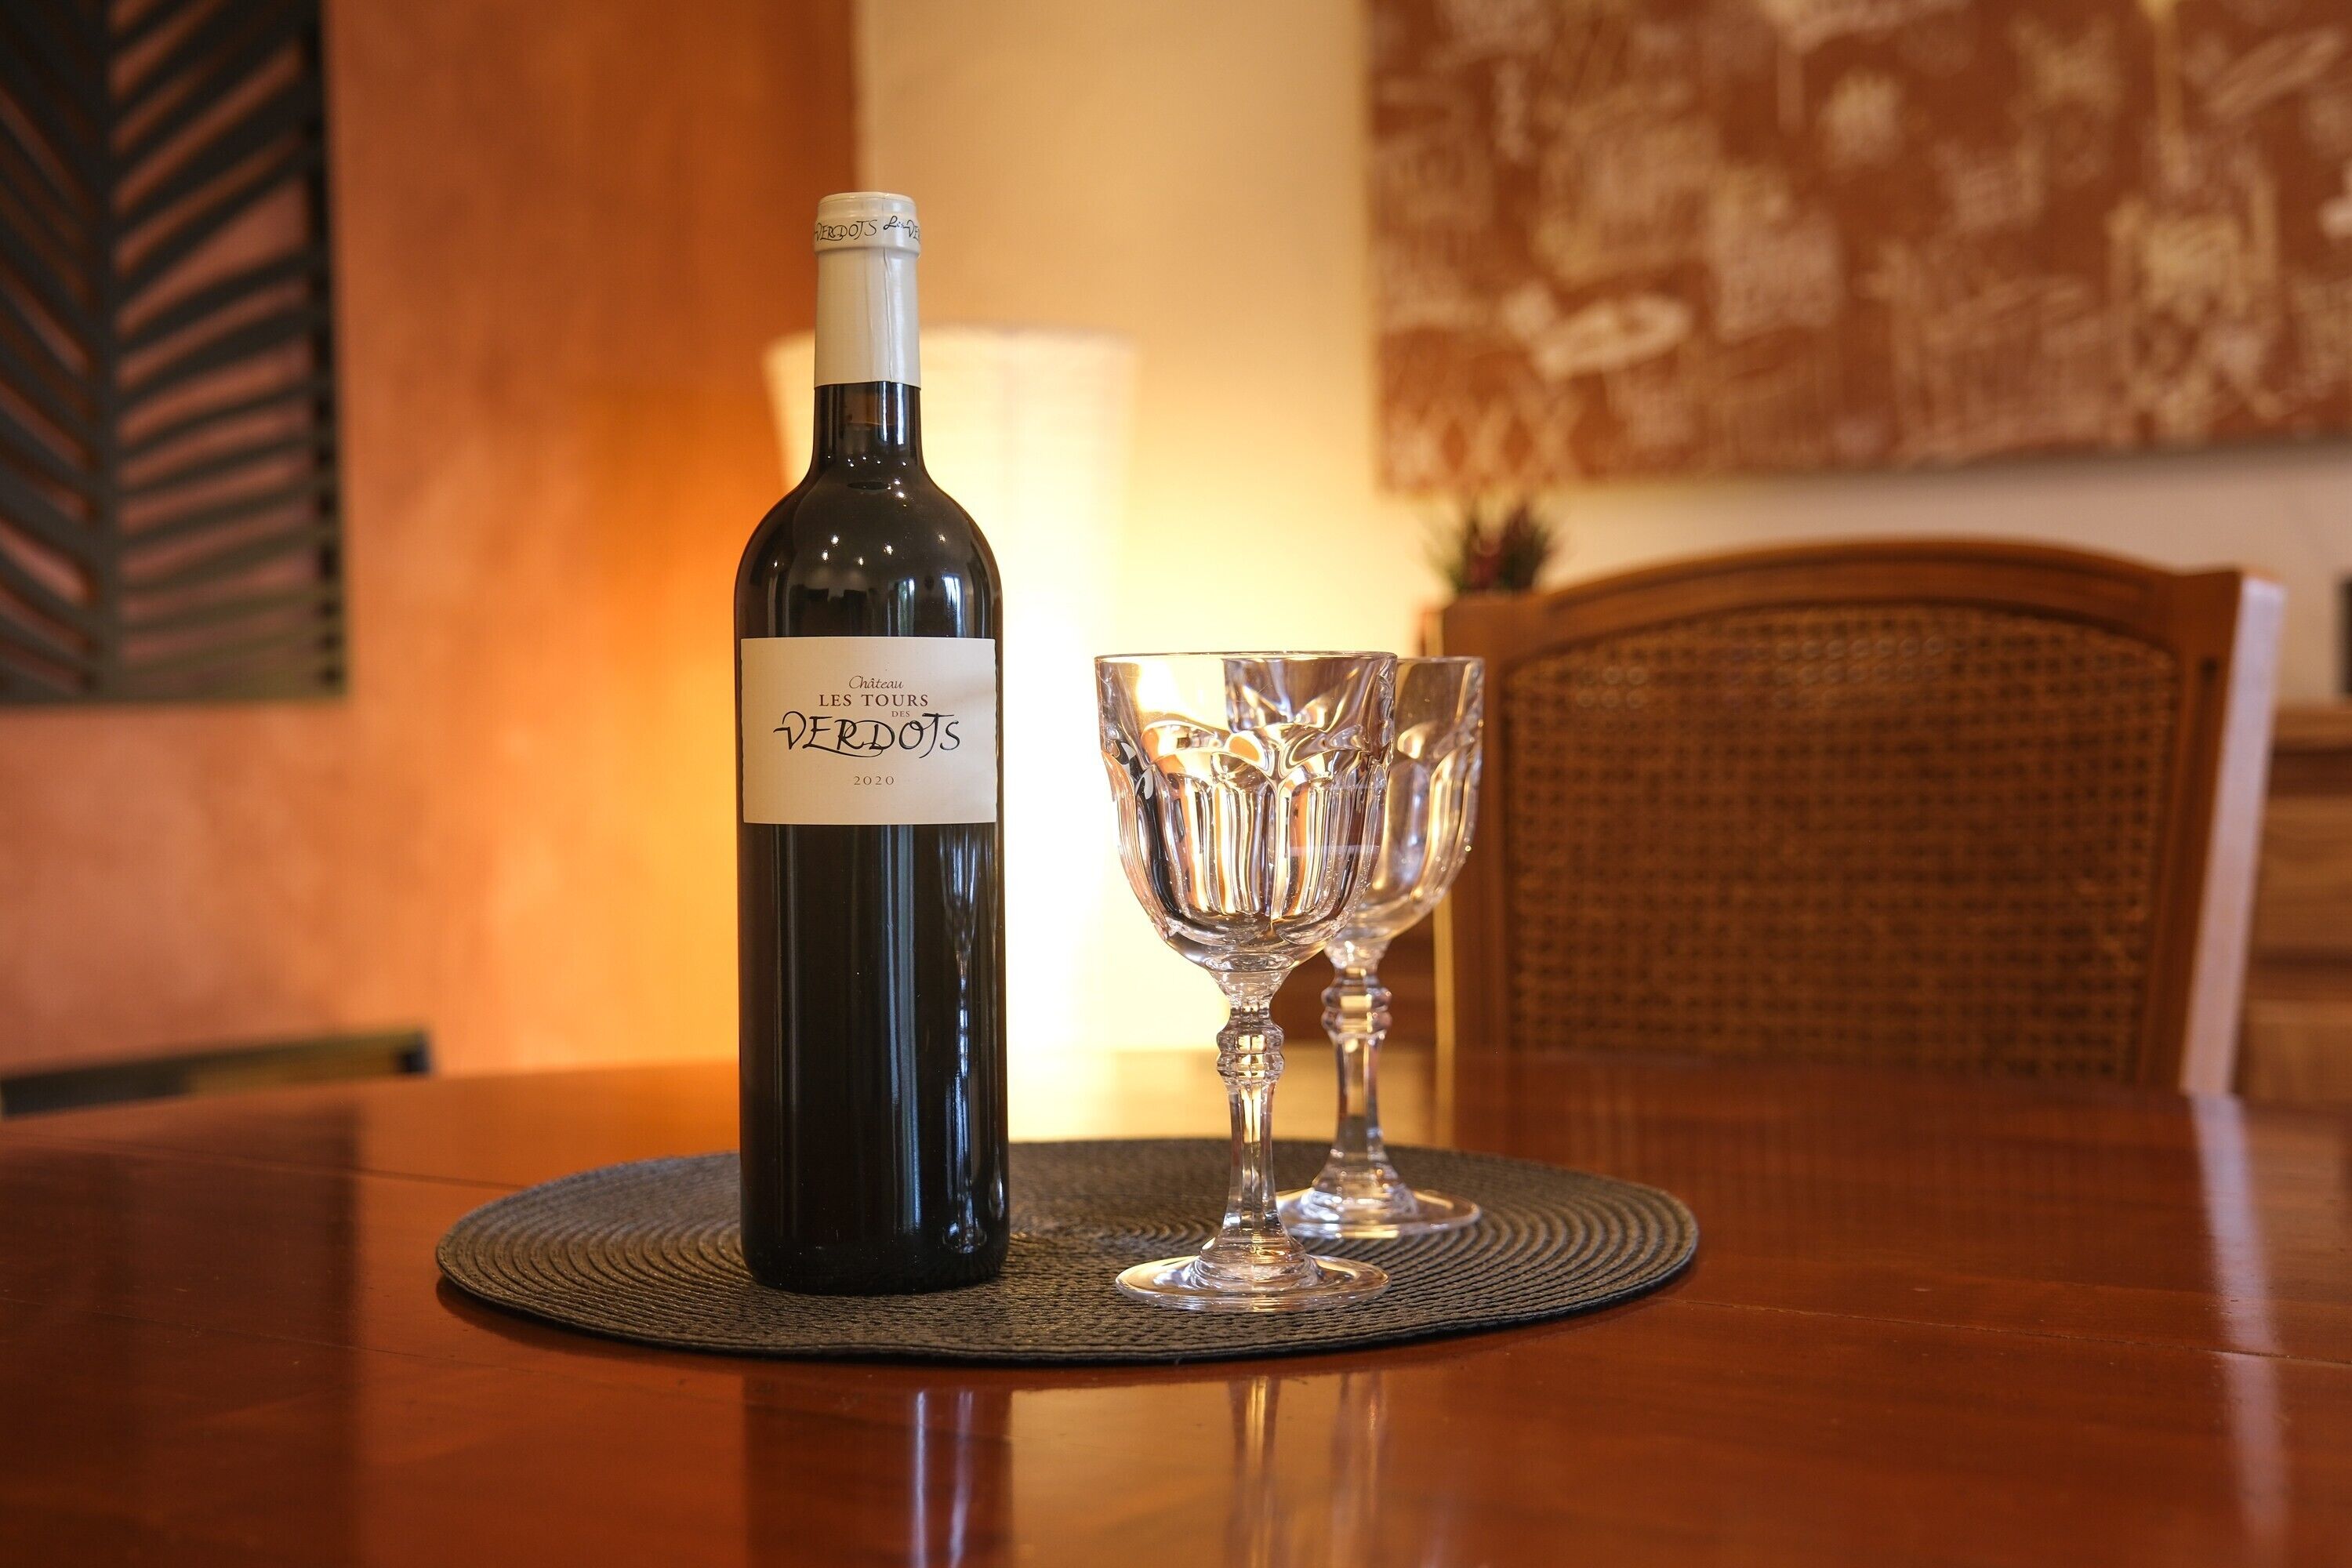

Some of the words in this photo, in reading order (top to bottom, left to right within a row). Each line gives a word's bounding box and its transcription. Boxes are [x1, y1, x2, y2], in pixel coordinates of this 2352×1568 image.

[848, 675, 903, 689] Château
[819, 694, 851, 707] LES
[861, 694, 928, 707] TOURS
[773, 711, 960, 759] VERDOTS
[854, 775, 895, 786] 2020
